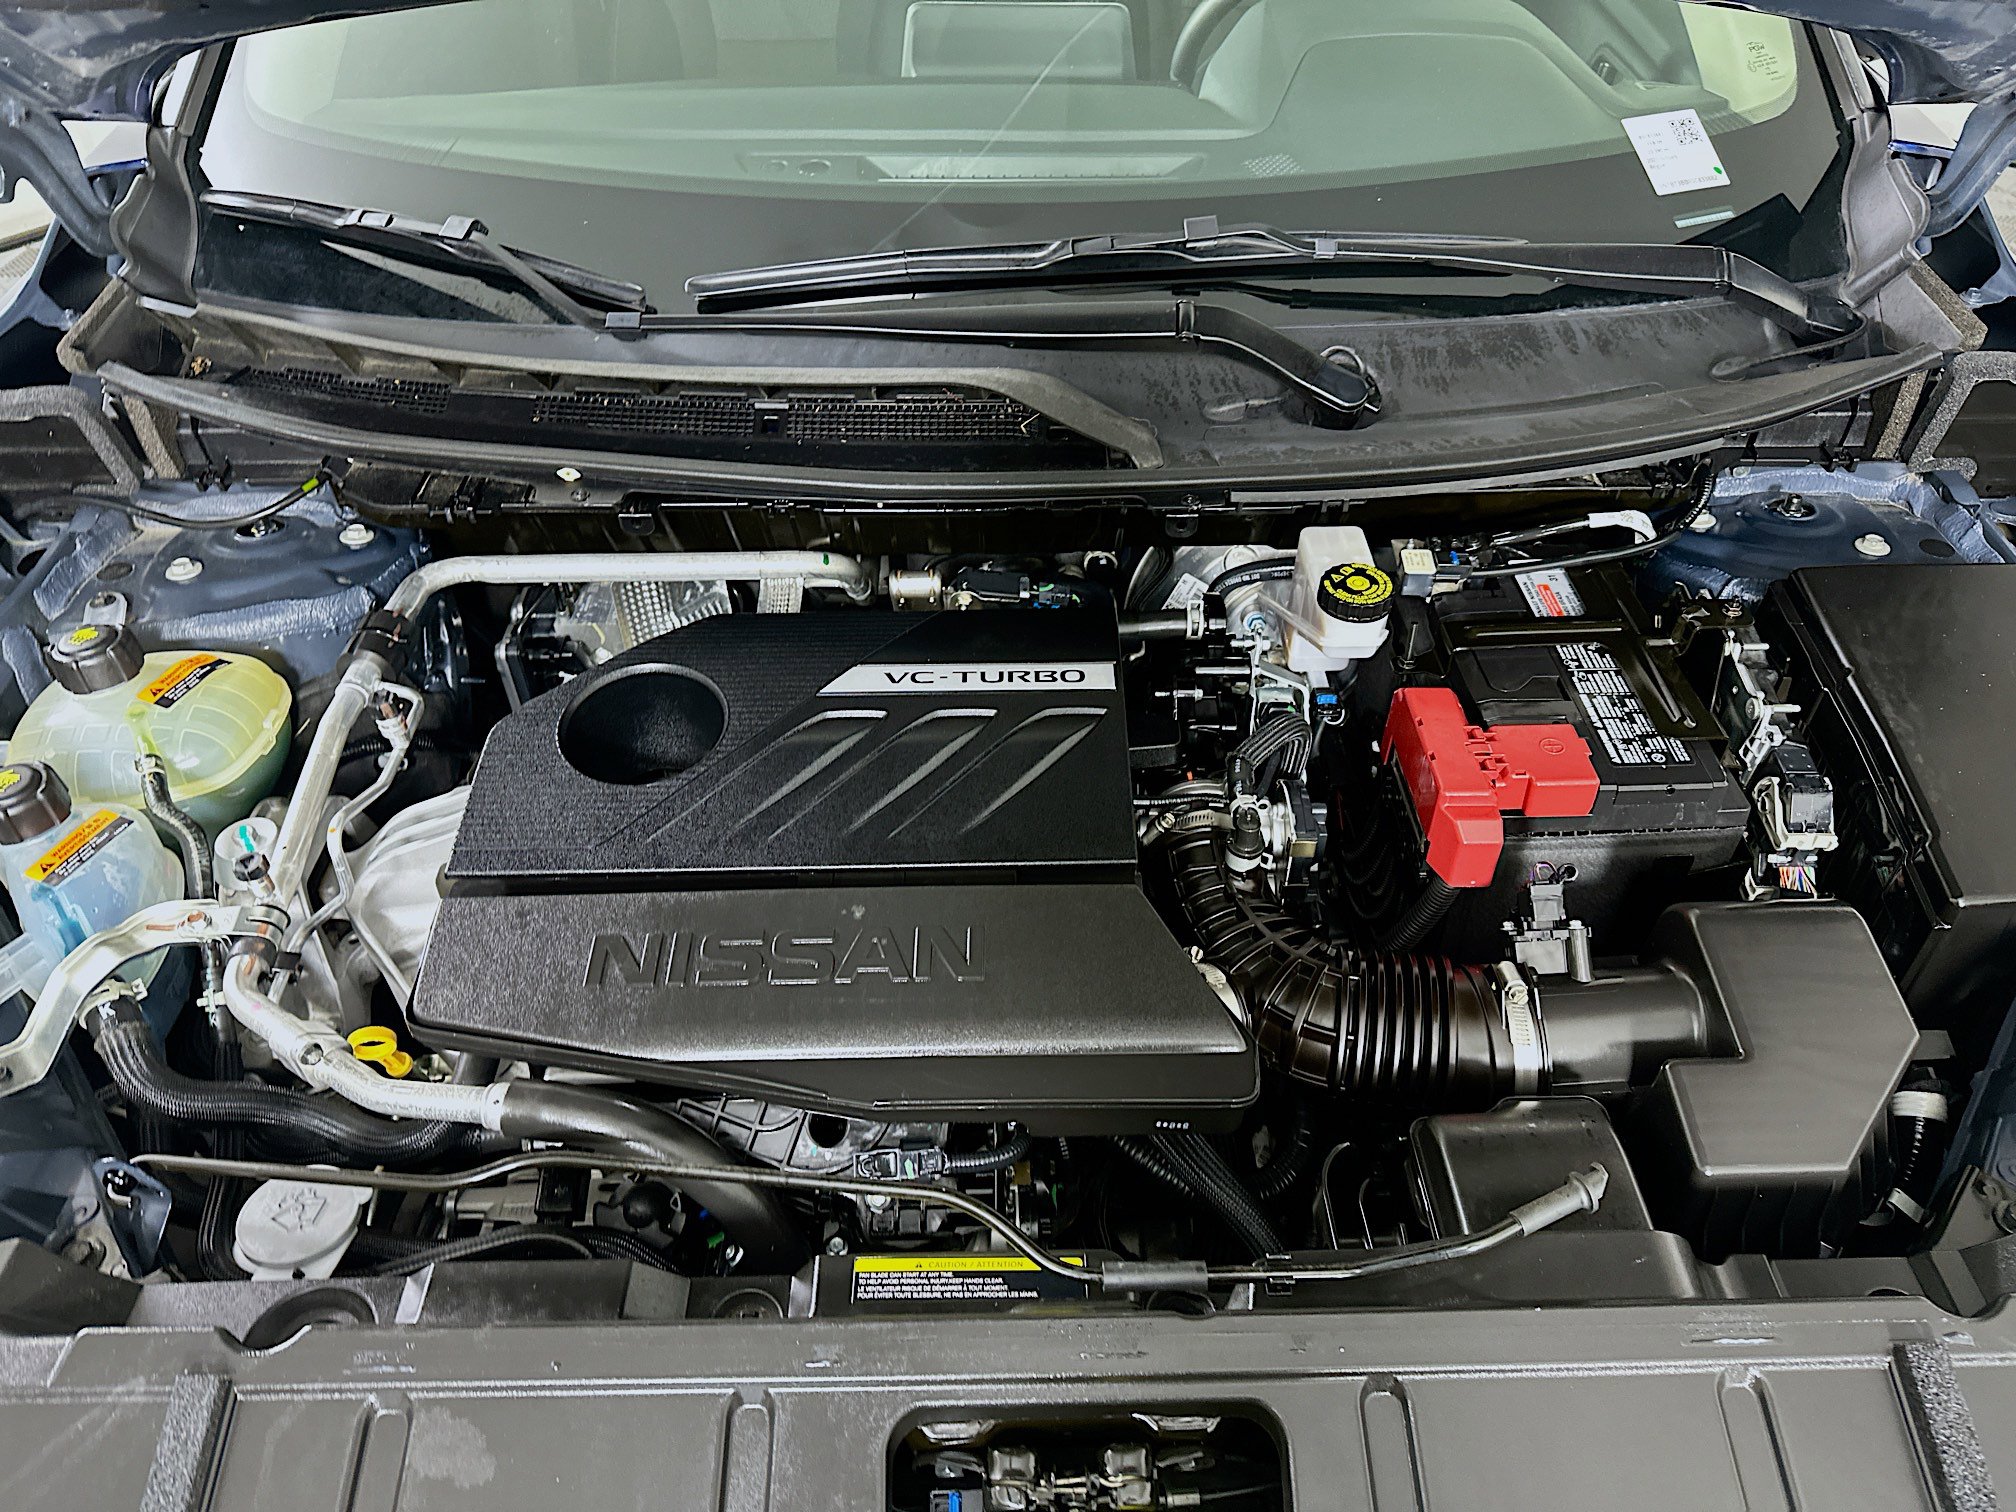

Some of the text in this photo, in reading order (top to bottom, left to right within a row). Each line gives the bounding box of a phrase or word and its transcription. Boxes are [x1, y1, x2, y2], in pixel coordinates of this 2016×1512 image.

[884, 668, 1086, 684] VC-TURBO
[582, 926, 985, 987] NISSAN
[976, 1260, 1023, 1268] ATTENTION
